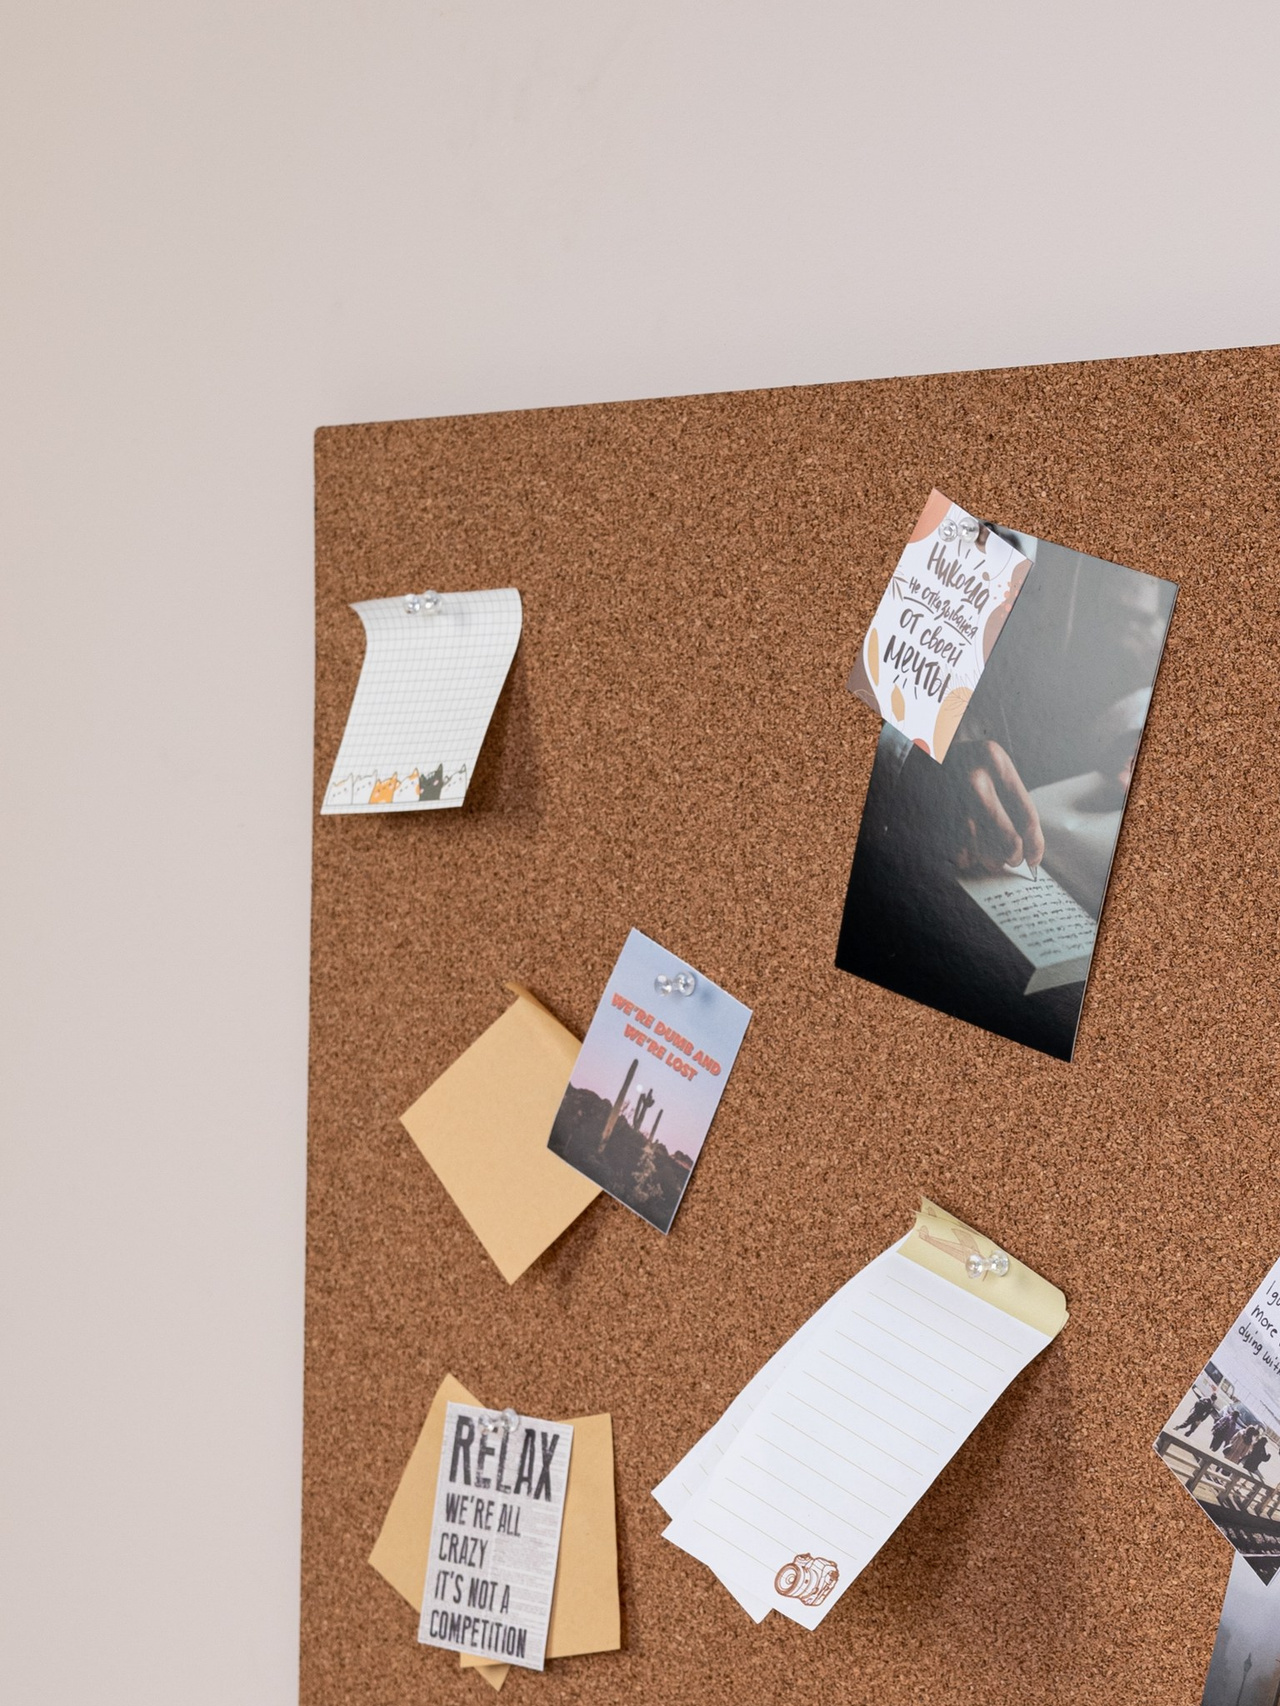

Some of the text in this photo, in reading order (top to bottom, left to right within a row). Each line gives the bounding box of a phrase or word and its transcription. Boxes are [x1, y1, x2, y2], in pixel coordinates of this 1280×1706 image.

[611, 992, 721, 1076] WE'RE DUMB AND
[624, 1023, 698, 1081] WE'RE LOST
[1266, 1280, 1276, 1295] I
[1238, 1322, 1263, 1356] dying
[449, 1415, 560, 1502] RELAX
[445, 1493, 521, 1537] WE'RE ALL
[439, 1532, 488, 1569] CRAZY
[434, 1570, 511, 1614] IT'S NOT A
[429, 1609, 527, 1659] COMPETITION
